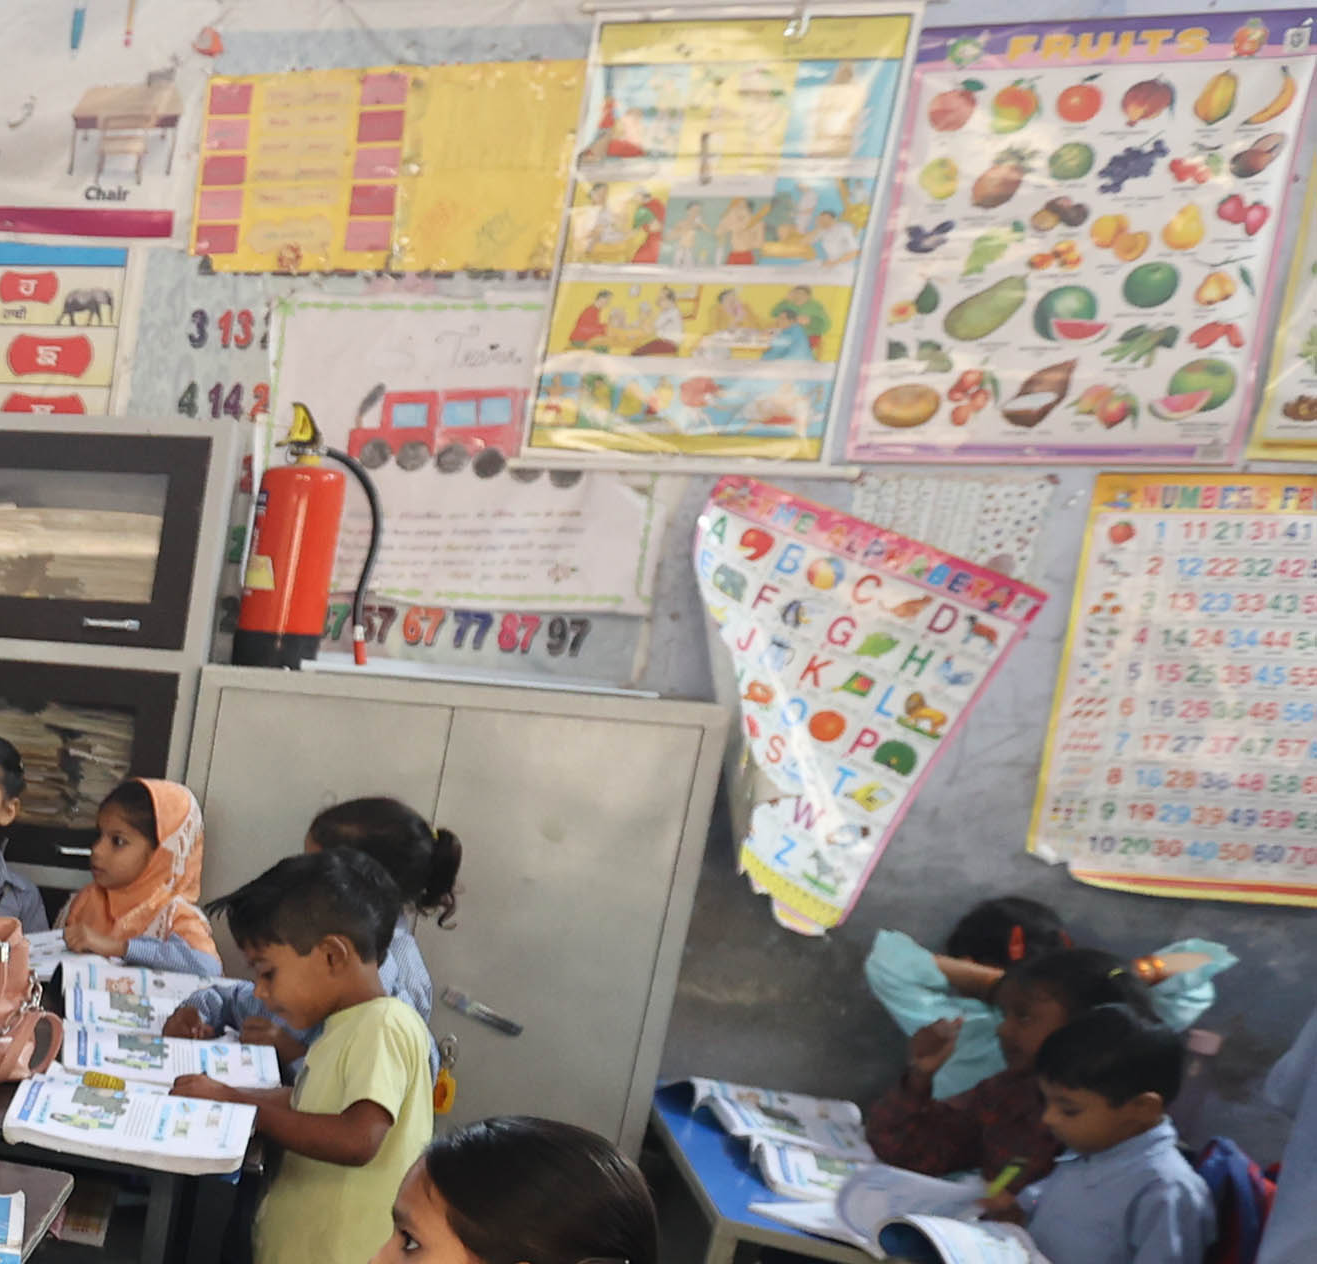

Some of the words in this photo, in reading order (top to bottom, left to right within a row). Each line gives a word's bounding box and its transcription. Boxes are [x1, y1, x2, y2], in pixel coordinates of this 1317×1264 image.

[1005, 27, 1211, 62] FRUITS
[84, 186, 131, 202] Chair
[188, 308, 209, 349] 3
[218, 308, 255, 349] 13
[177, 381, 199, 419] 4
[208, 381, 243, 422] 14
[1155, 521, 1167, 541] 1
[1182, 521, 1208, 539] 11
[1213, 521, 1245, 540] 21
[1248, 521, 1279, 540] 31
[1284, 521, 1312, 539] 41
[707, 515, 729, 544] A
[774, 543, 806, 575] B
[851, 574, 883, 605] C
[927, 602, 959, 634] D
[1145, 556, 1164, 576] 2
[1177, 557, 1203, 576] 12
[1205, 558, 1239, 577] 22
[1242, 558, 1273, 577] 32
[1275, 559, 1306, 578] 42
[1168, 592, 1197, 611] 13
[1199, 592, 1232, 612] 23
[1234, 593, 1265, 612] 33
[1268, 594, 1300, 613] 43
[402, 605, 447, 646] 67
[453, 608, 494, 651] 77
[497, 611, 543, 654] 87
[546, 615, 591, 658] 97
[751, 584, 781, 610] F
[826, 615, 857, 649] G
[900, 644, 934, 678] H
[1133, 627, 1149, 644] 4
[1162, 628, 1188, 646] 14
[1191, 628, 1224, 647] 24
[1228, 628, 1260, 648] 34
[1260, 631, 1292, 648] 44
[736, 627, 757, 651] J
[798, 655, 835, 688] K
[874, 685, 896, 718] L
[1128, 662, 1142, 680] 5
[1154, 663, 1183, 683] 15
[1185, 664, 1215, 684] 25
[1221, 665, 1252, 684] 35
[1255, 666, 1287, 685] 45
[1118, 697, 1136, 717] 6
[781, 697, 808, 729] O
[848, 726, 881, 756] P
[1115, 732, 1131, 751] 7
[1141, 734, 1171, 751] 17
[1173, 736, 1205, 753] 27
[1207, 736, 1240, 754] 37
[1277, 738, 1308, 757] 57
[764, 736, 786, 765] S
[830, 766, 859, 797] T
[1106, 767, 1123, 785] 8
[791, 799, 826, 831] W
[1101, 801, 1116, 820] 9
[772, 836, 800, 866] Z
[1089, 834, 1117, 852] 10
[1118, 835, 1152, 854] 20
